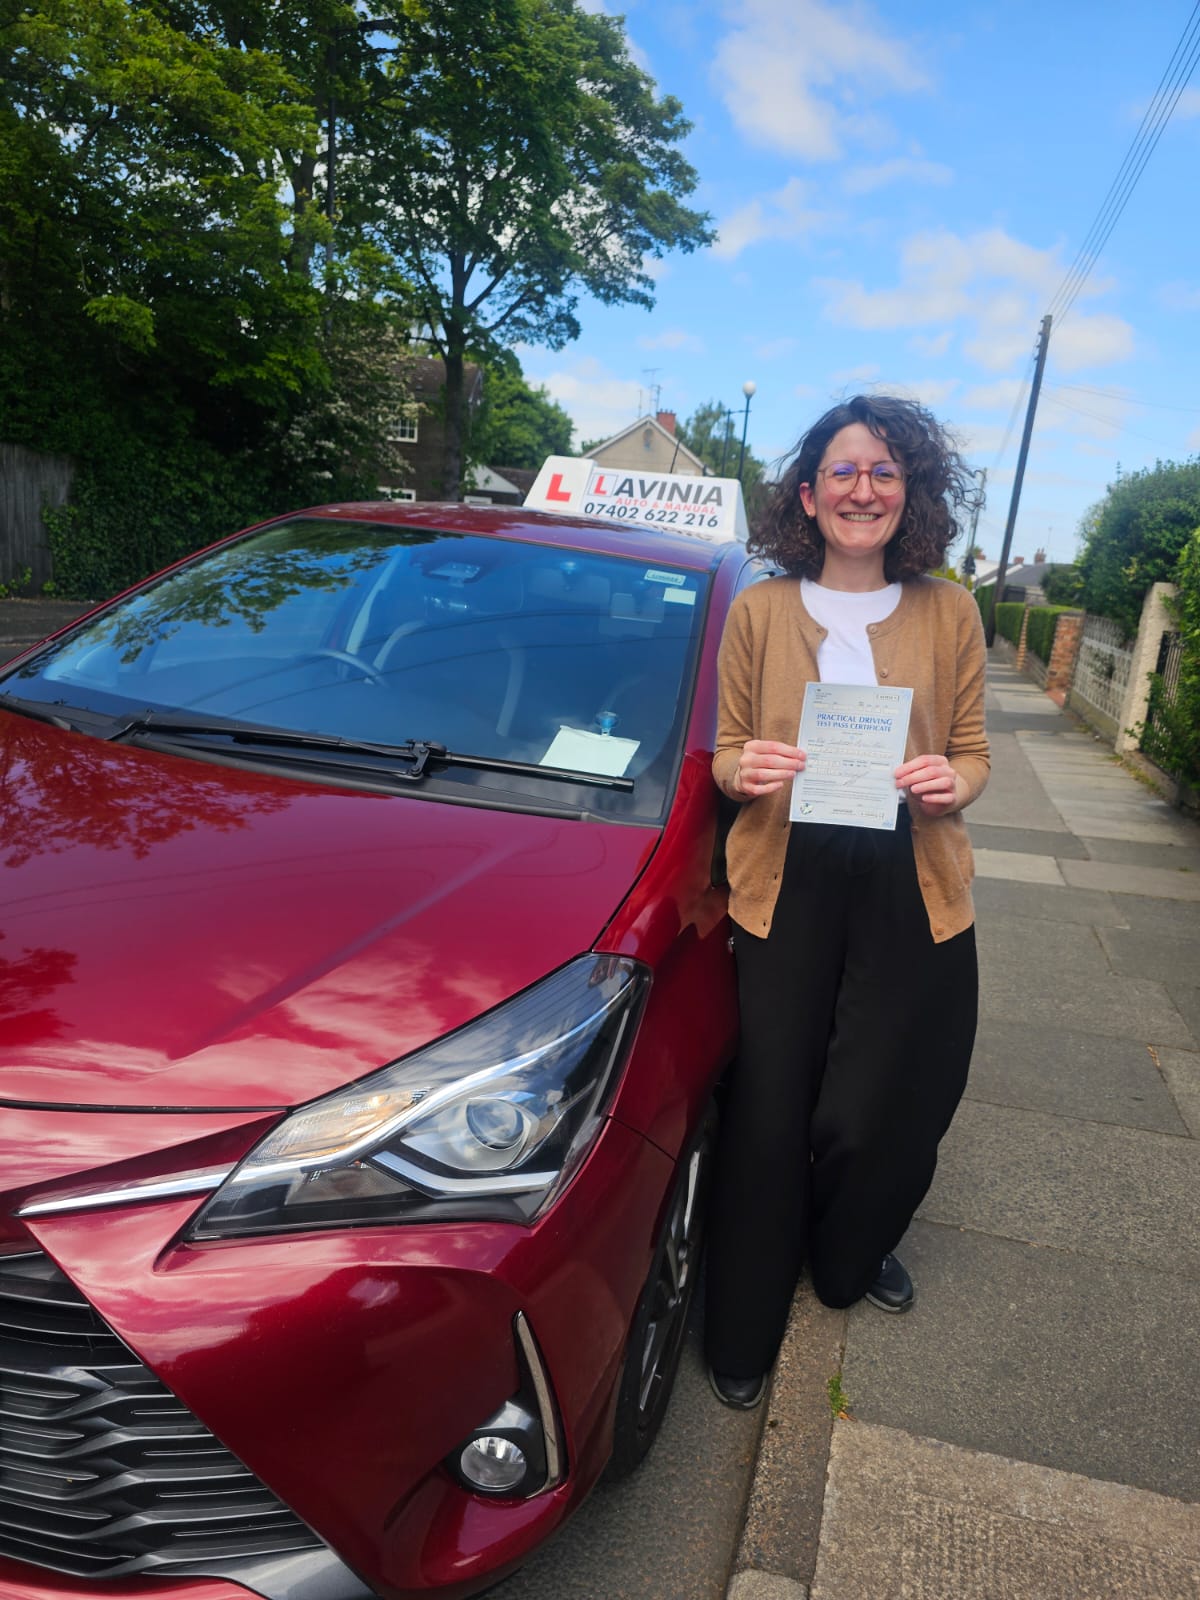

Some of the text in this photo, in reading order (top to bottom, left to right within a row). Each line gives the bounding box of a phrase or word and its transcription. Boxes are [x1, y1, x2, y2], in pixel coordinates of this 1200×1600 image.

[545, 473, 572, 502] L
[593, 475, 723, 506] LAVINIA
[584, 502, 719, 528] 07402 622 216
[615, 497, 716, 514] AUTO & MANUAL
[817, 713, 892, 725] PRACTICAL DRIVING
[850, 723, 892, 732] CERTIFICATE
